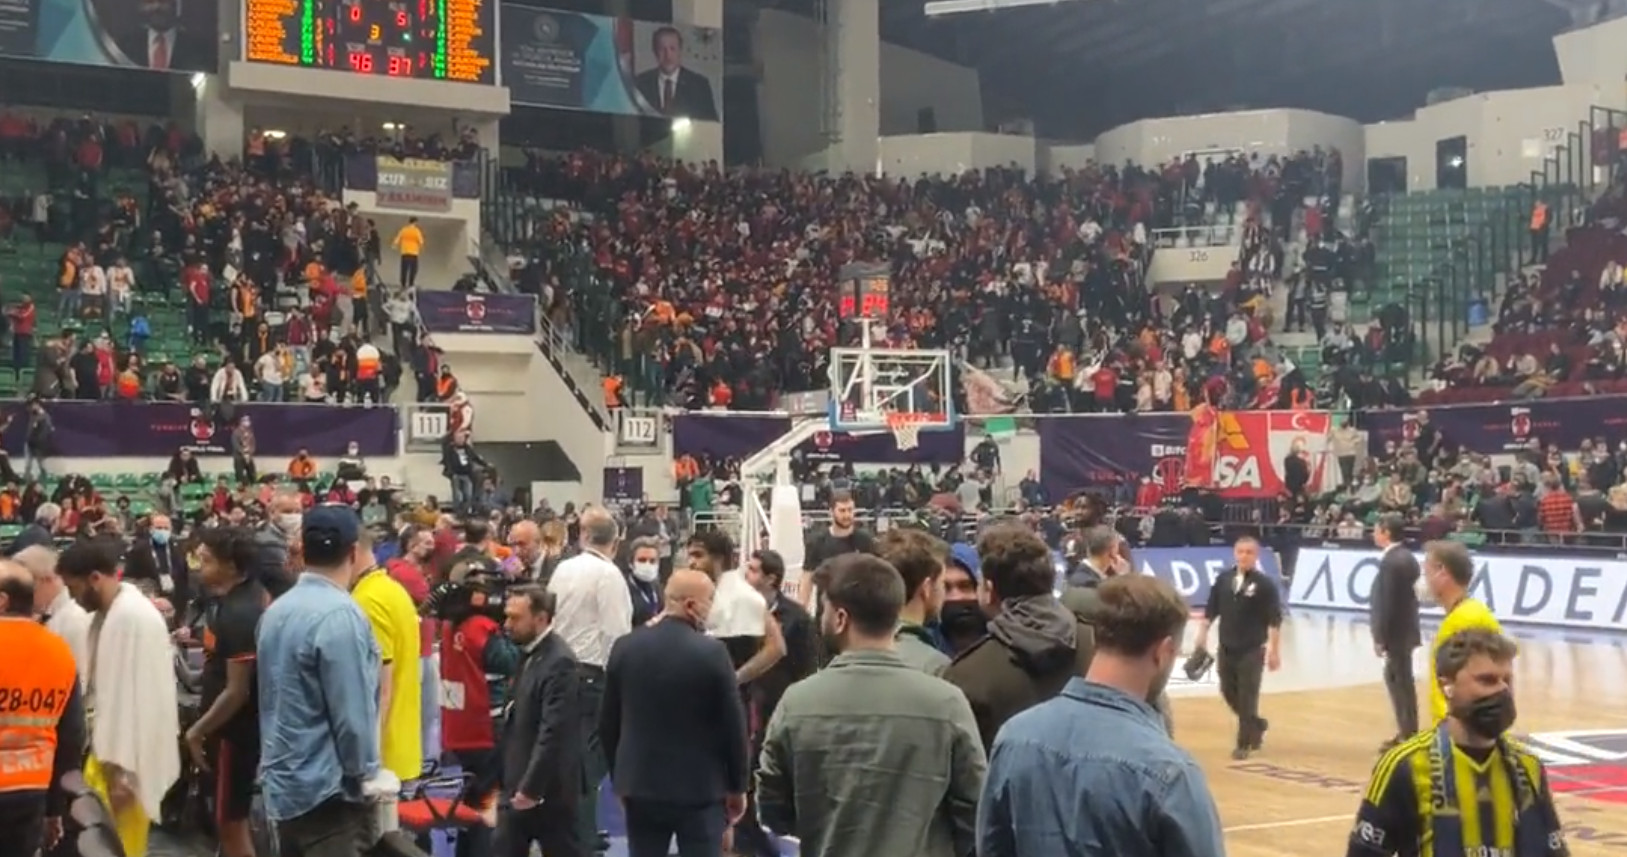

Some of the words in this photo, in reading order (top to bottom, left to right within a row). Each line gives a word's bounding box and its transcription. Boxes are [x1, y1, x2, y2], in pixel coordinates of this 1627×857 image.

[349, 53, 373, 72] 46
[388, 56, 412, 75] 37
[419, 416, 442, 435] 111
[627, 420, 653, 438] 112
